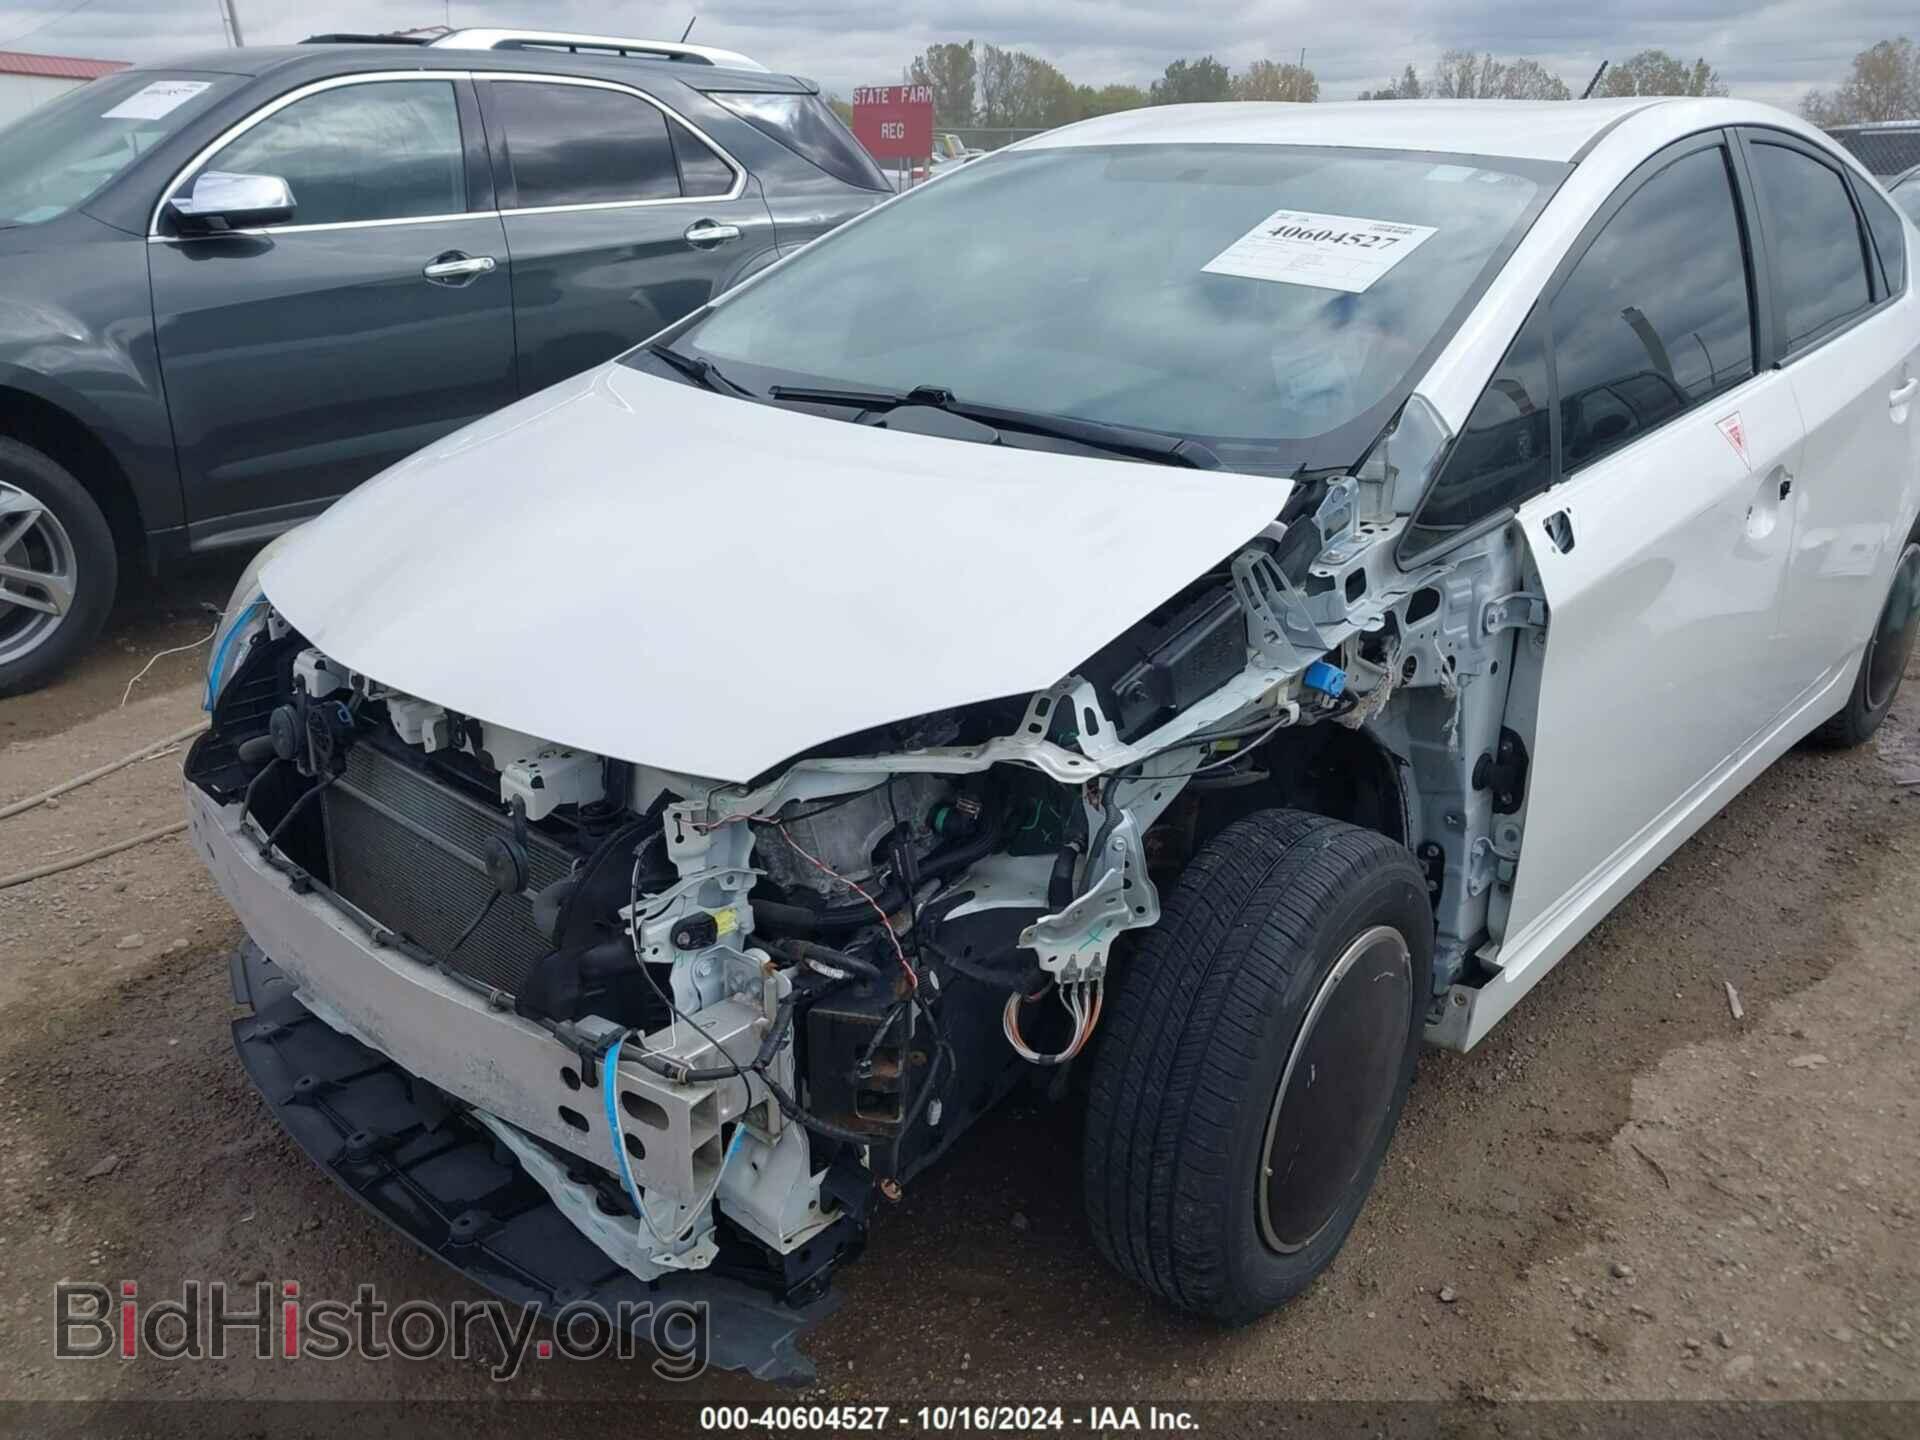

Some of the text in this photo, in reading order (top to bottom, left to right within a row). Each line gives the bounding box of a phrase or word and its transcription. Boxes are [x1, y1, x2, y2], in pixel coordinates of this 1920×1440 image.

[854, 86, 933, 105] STATE FARM
[1267, 224, 1401, 250] 40604527
